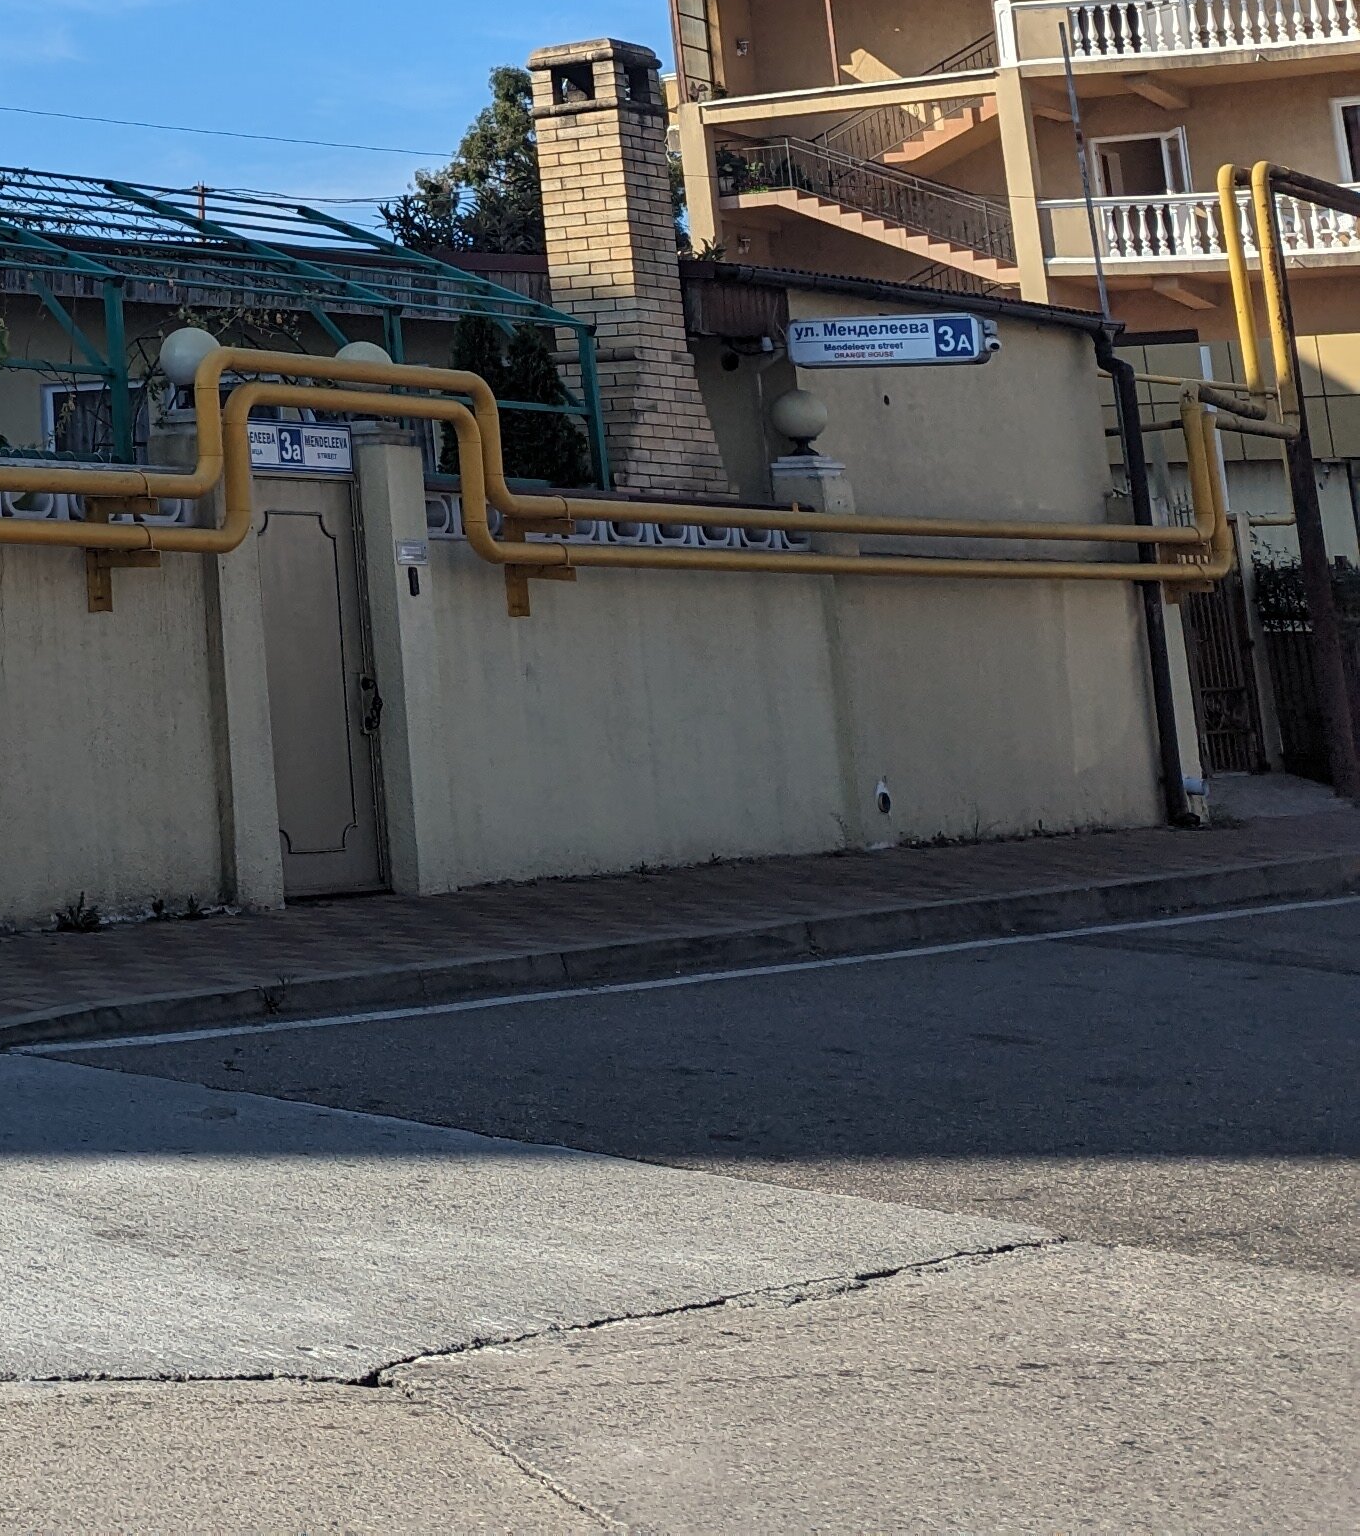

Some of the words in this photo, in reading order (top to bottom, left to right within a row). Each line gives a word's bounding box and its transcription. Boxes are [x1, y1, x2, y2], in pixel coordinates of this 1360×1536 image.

[794, 325, 819, 340] ул.
[823, 321, 929, 337] Менделеева
[878, 342, 904, 350] street
[249, 431, 276, 445] ЕЛЕЕВА
[304, 435, 348, 450] MENDELEEVA
